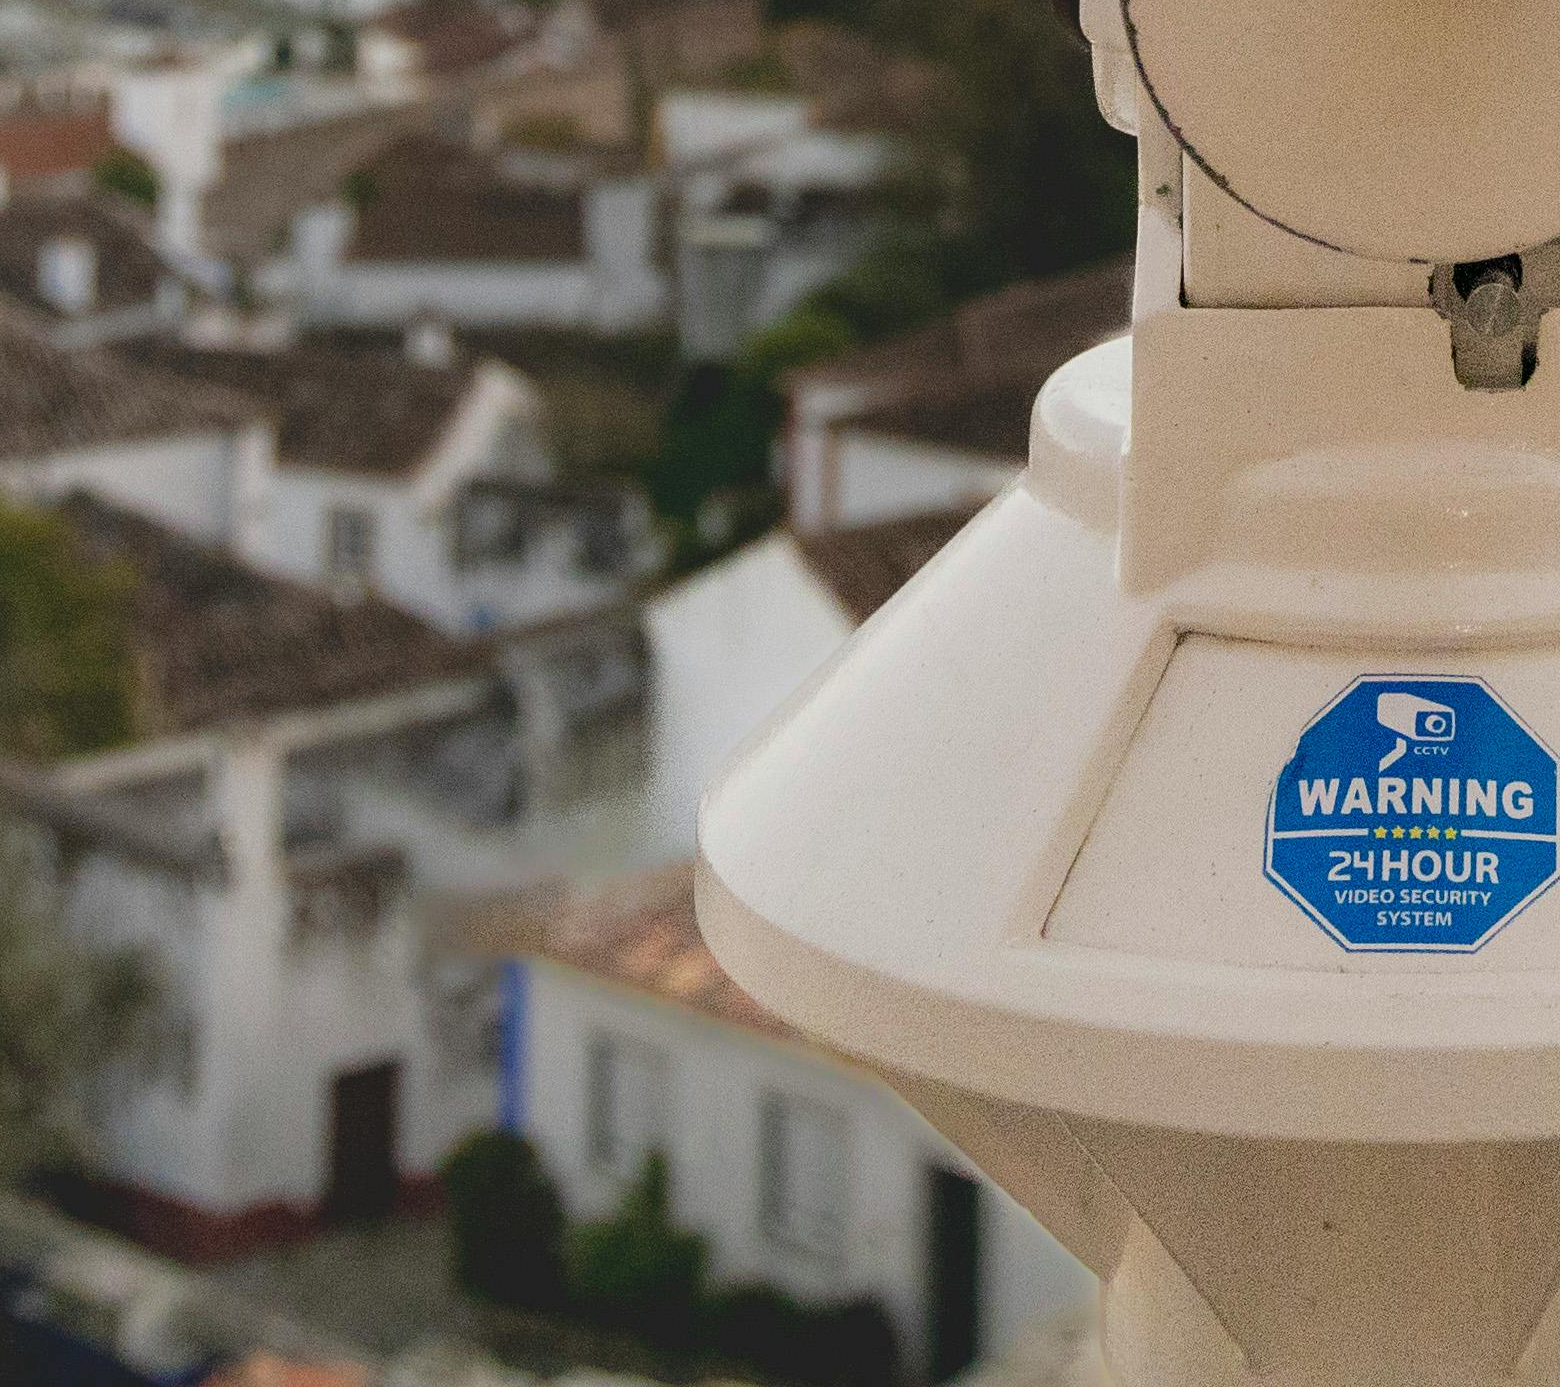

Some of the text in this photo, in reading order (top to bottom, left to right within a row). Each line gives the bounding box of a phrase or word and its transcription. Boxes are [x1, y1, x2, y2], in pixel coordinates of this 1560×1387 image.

[1413, 746, 1449, 755] CCTV
[1298, 777, 1534, 819] WARNING
[1334, 888, 1492, 906] VIDEO SECURITY
[1376, 911, 1452, 927] SYSTEM
